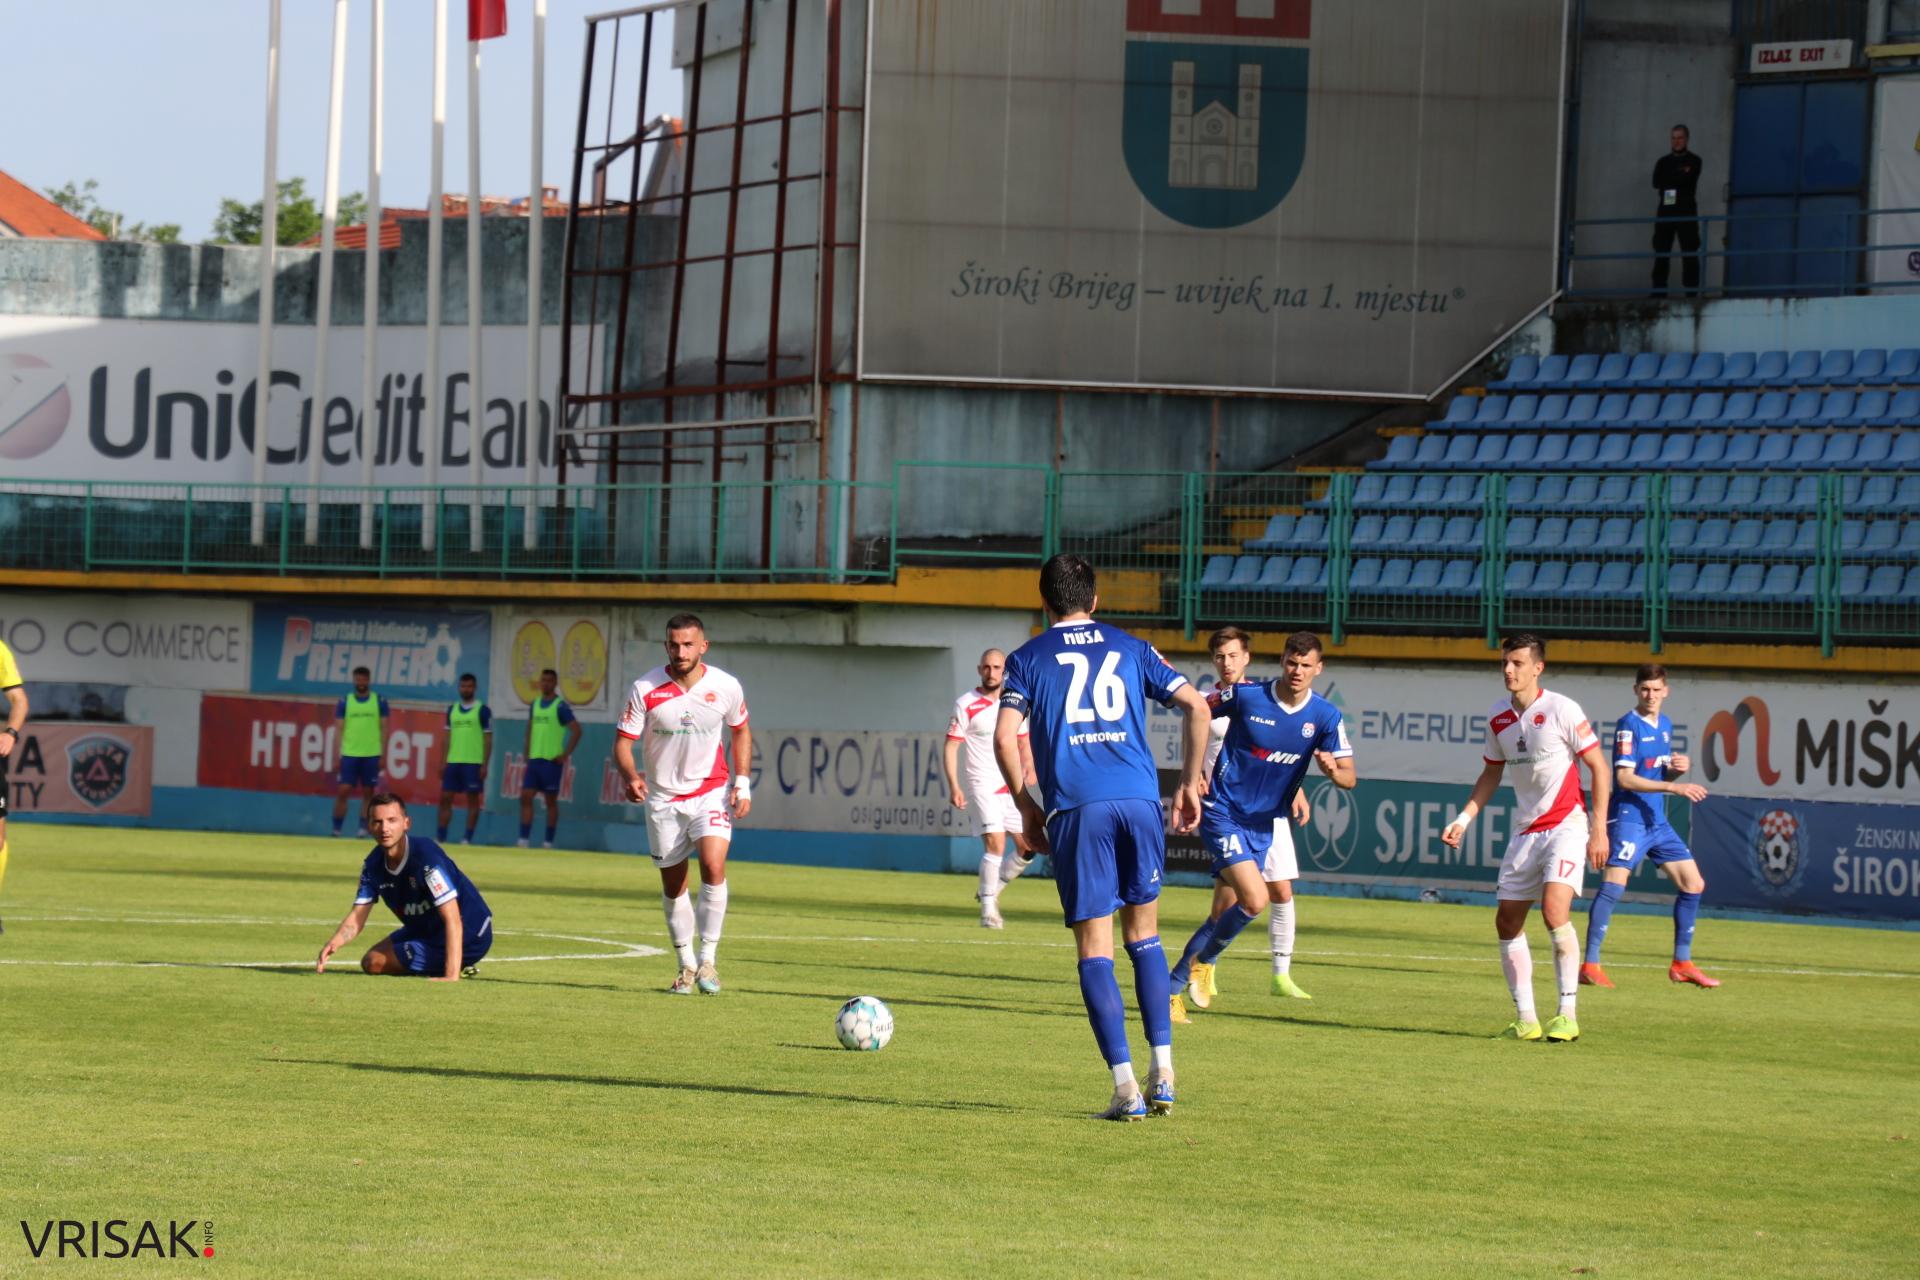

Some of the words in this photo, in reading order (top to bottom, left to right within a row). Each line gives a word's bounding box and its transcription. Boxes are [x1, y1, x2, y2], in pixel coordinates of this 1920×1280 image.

[1758, 49, 1793, 65] IZLAZ
[1799, 47, 1825, 62] EXIT
[951, 260, 1037, 305] Široki
[1048, 271, 1137, 312] Brijeg
[1175, 275, 1270, 315] uvijek
[1272, 284, 1308, 309] na
[1320, 282, 1342, 309] 1.
[441, 371, 585, 469] Bank
[64, 620, 240, 664] COMMERCE
[1062, 629, 1105, 645] MUSA
[277, 616, 433, 687] PREMIER
[1055, 650, 1126, 724] 26
[1250, 715, 1276, 727] KELME
[1361, 710, 1488, 745] EMERUS
[777, 736, 946, 798] CROATIA
[851, 804, 936, 831] osiguranje
[1218, 833, 1243, 859] 24
[1617, 840, 1636, 861] 29
[1855, 824, 1905, 850] ŽENSKI
[1558, 859, 1576, 878] 17
